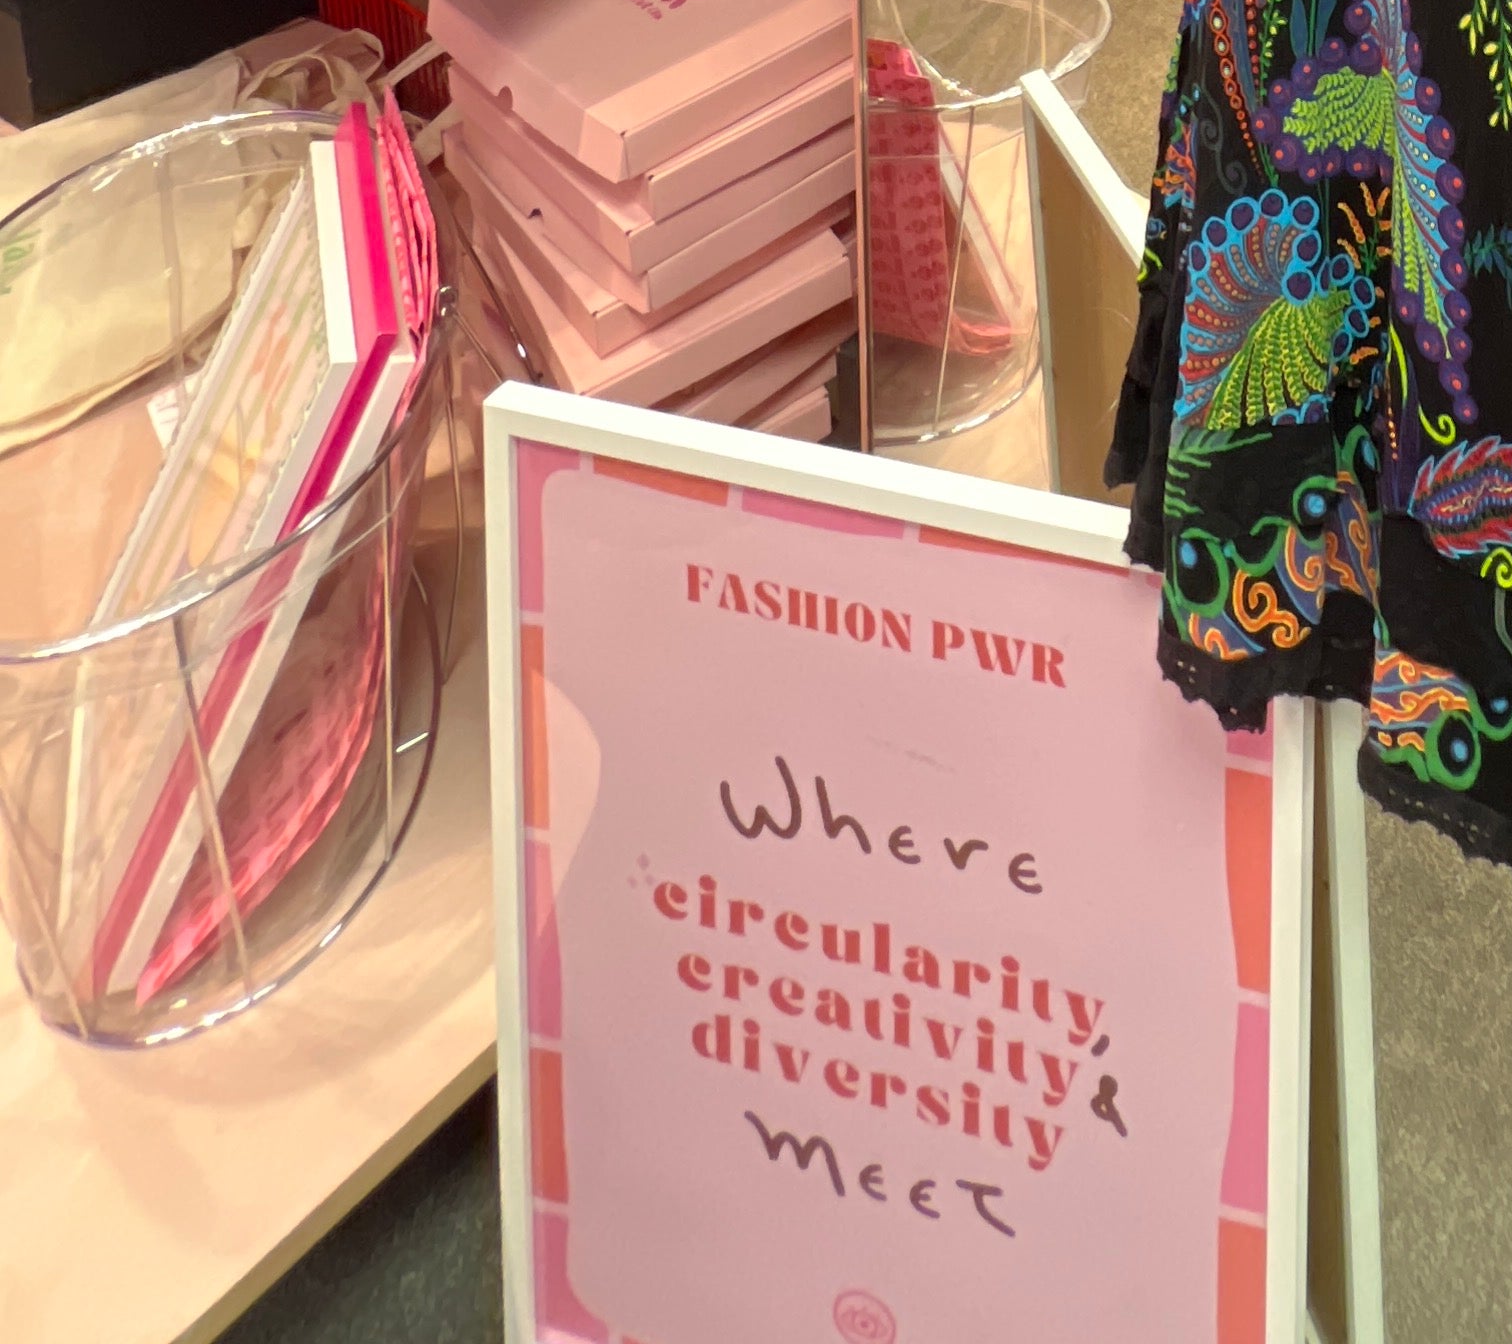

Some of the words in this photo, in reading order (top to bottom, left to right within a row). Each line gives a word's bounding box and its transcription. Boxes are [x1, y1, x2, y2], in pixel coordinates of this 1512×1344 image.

[686, 563, 912, 653] FASHION
[931, 619, 1067, 689] PWR
[676, 953, 1080, 1108] creativity
[691, 1015, 1065, 1172] diversity
